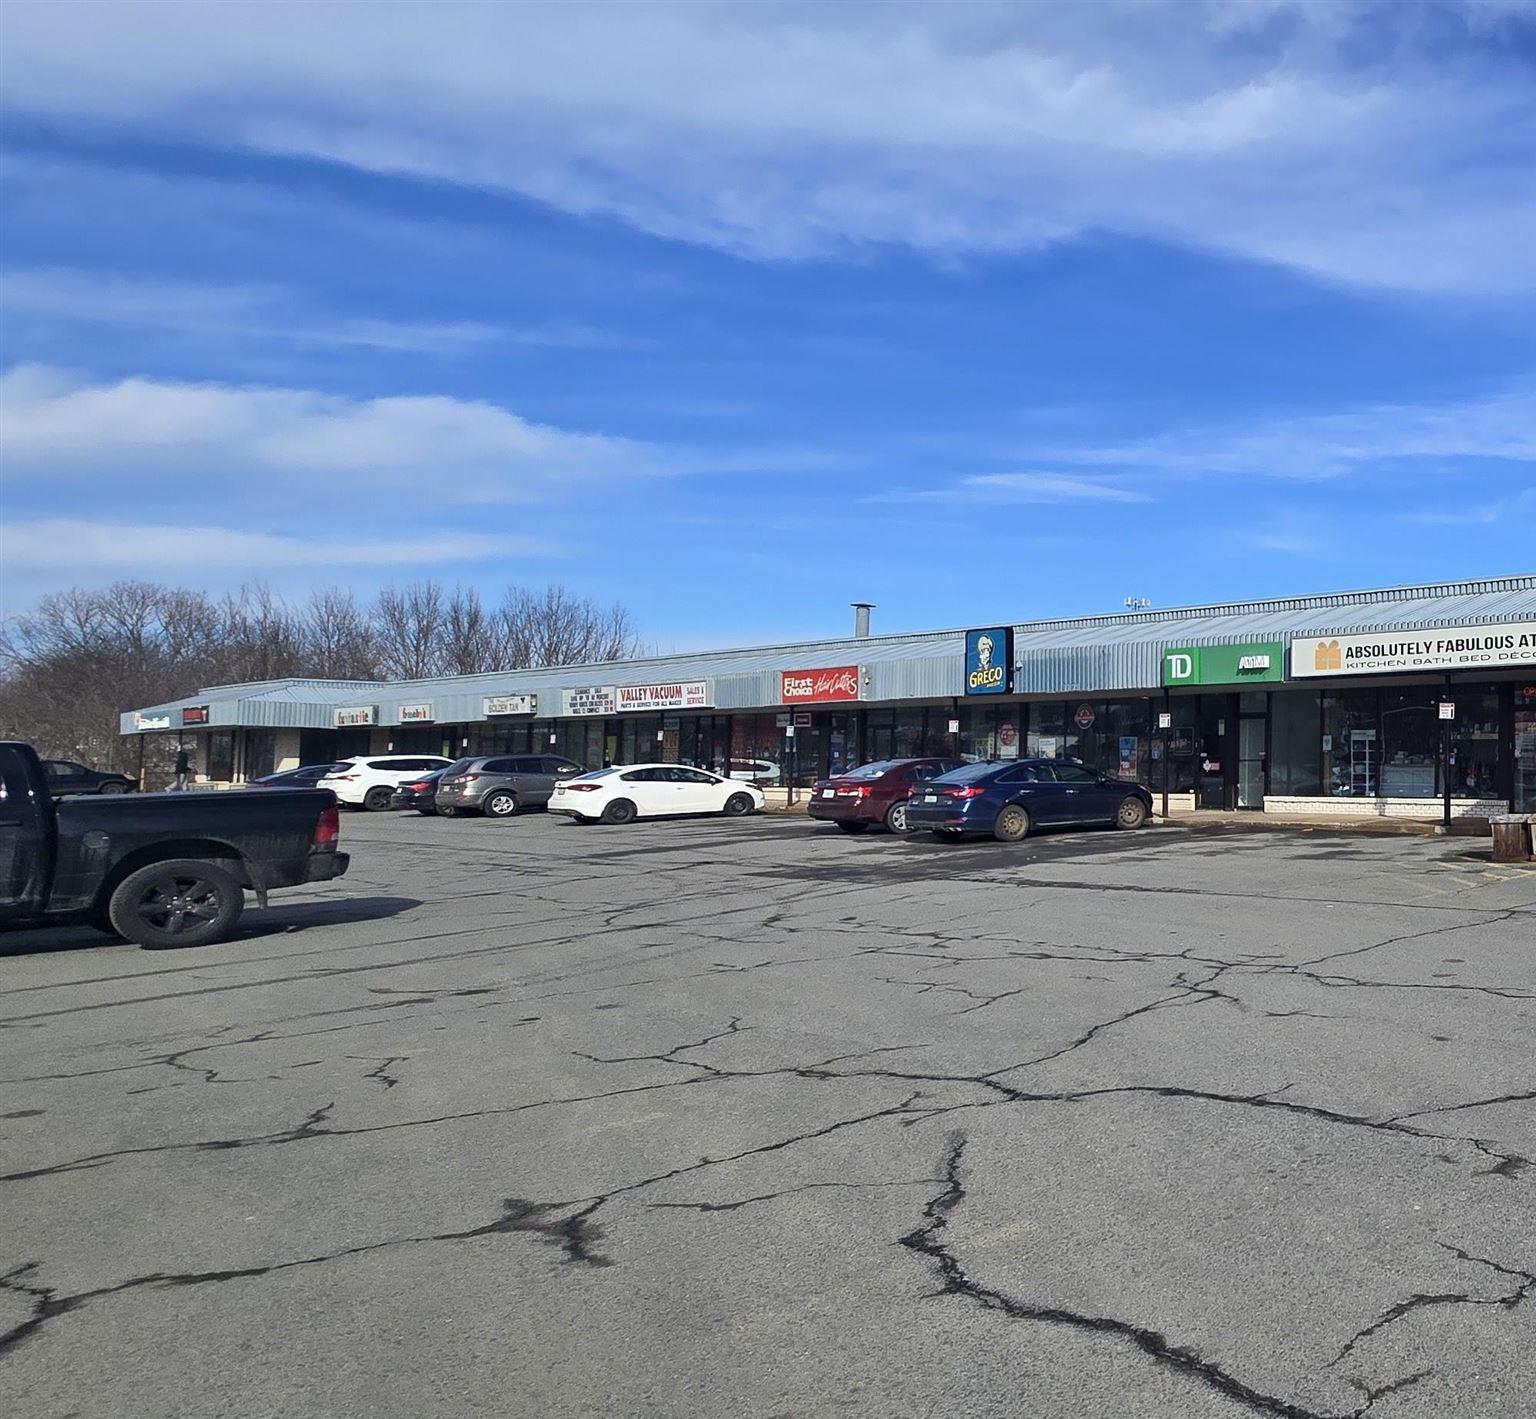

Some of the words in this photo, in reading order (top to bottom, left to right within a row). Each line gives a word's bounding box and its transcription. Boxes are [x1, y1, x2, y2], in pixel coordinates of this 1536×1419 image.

[1345, 640, 1433, 660] ABSOLUTELY
[1436, 634, 1514, 654] FABULOUS
[1166, 653, 1193, 679] TD
[1346, 659, 1407, 669] KITCHEN
[1413, 656, 1452, 665] BATH
[1459, 654, 1492, 663] BED
[784, 677, 813, 688] First
[969, 666, 1003, 688] GRECO
[620, 687, 648, 702] VALLEY
[649, 685, 682, 700] VACUUM
[686, 686, 700, 695] SALES
[783, 686, 813, 697] Choice
[686, 697, 704, 705] SERVICE
